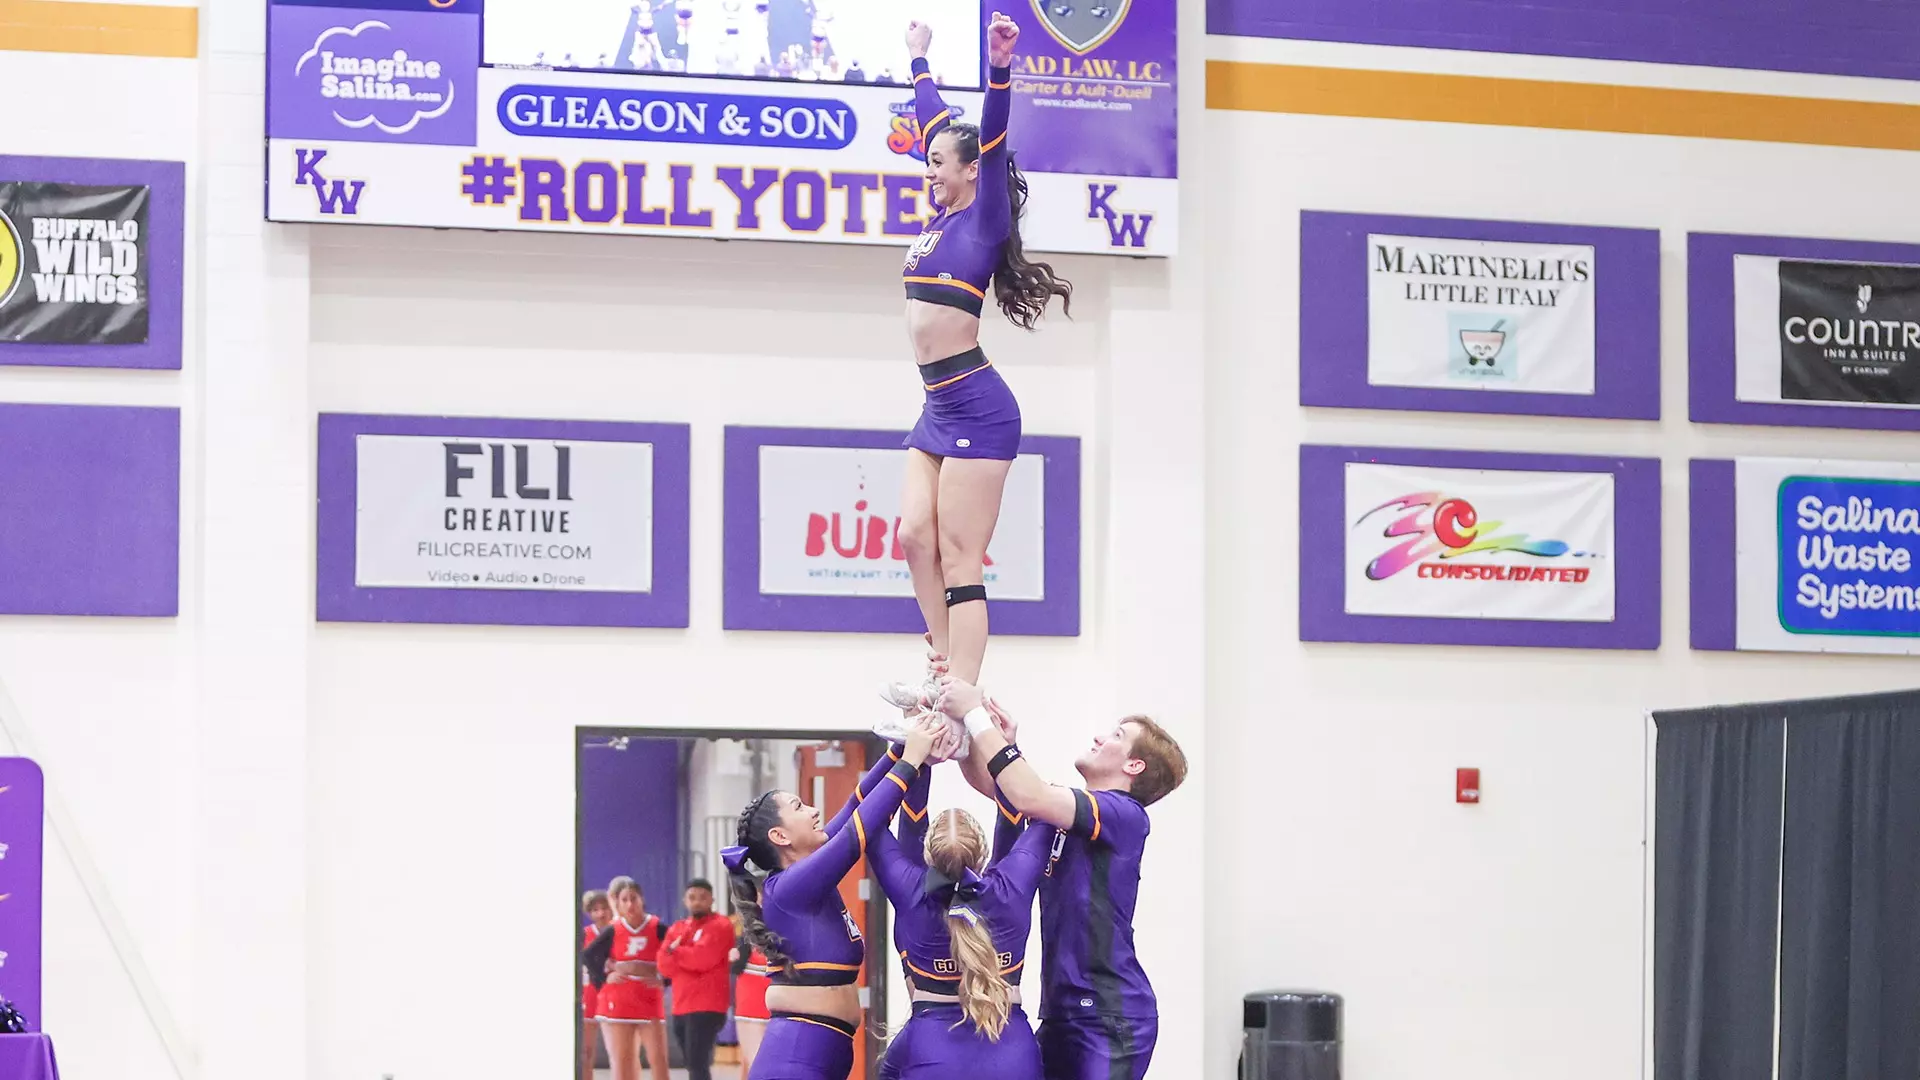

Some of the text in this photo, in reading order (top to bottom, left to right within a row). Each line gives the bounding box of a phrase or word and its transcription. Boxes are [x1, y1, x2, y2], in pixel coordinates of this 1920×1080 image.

[320, 49, 442, 83] Imagine
[1062, 56, 1123, 81] LAW,
[1012, 79, 1058, 95] Carter
[506, 94, 847, 142] GLEASON & SON
[31, 217, 139, 242] BUFFALO
[31, 239, 138, 275] WILD
[31, 272, 138, 305] WINGS
[1404, 281, 1561, 308] LITTLE ITALY
[1823, 348, 1907, 362] INN & SUITES
[442, 442, 574, 501] FILI
[444, 507, 570, 533] CREATIVE
[1796, 495, 1920, 534] Salina
[416, 541, 592, 560] FILICREATIVE.COM
[1797, 534, 1912, 572] Waste
[427, 570, 586, 586] Video Audio Drone
[1417, 562, 1590, 584] CONSOLIDATED
